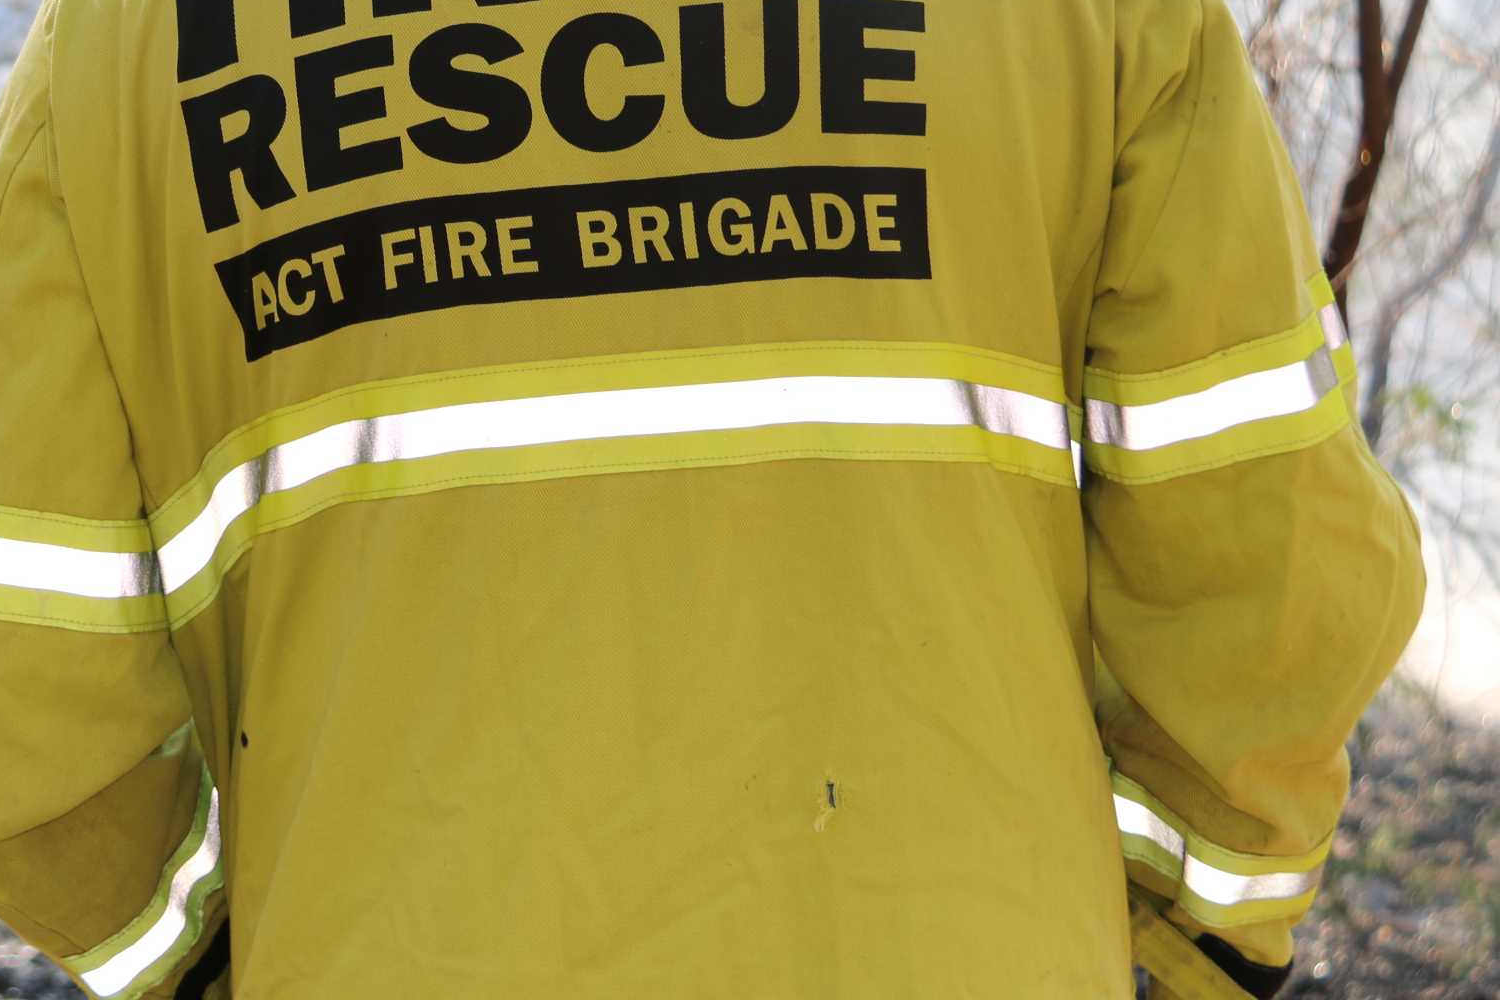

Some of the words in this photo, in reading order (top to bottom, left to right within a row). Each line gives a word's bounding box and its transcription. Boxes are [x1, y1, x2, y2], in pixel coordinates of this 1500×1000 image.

[252, 245, 346, 331] ACT
[381, 216, 539, 291] FIRE
[577, 193, 902, 269] BRIGADE
